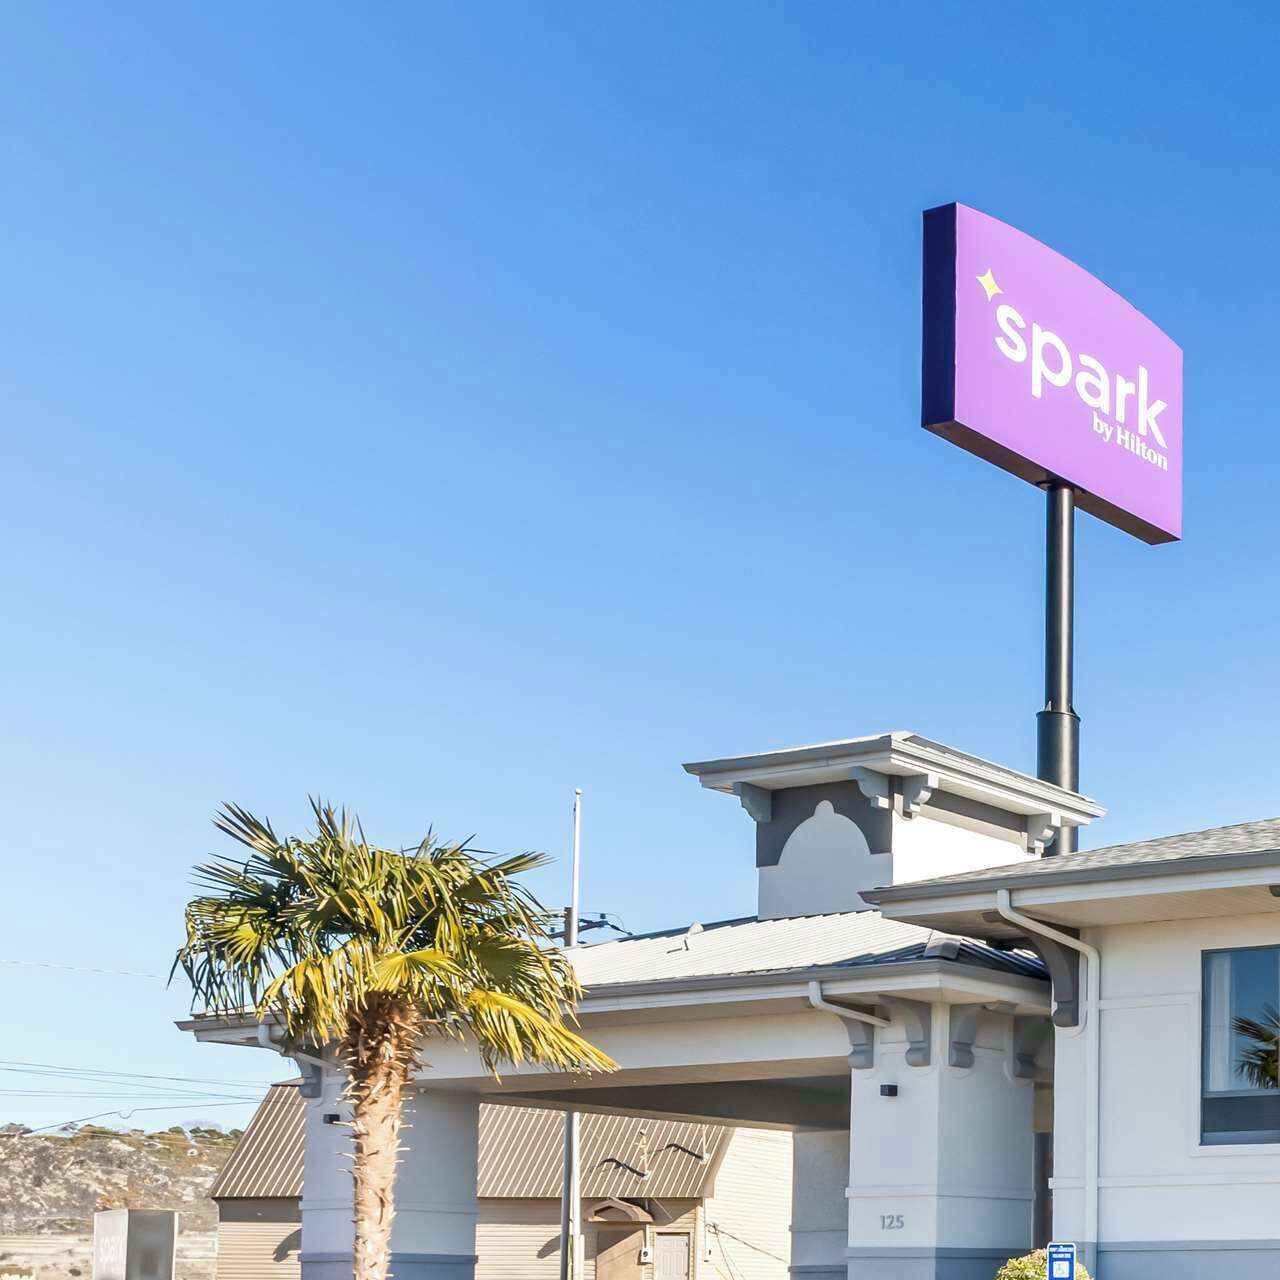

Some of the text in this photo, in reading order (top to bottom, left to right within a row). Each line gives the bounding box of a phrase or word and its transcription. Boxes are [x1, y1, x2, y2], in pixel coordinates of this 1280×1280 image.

[994, 304, 1169, 450] spark
[1093, 411, 1168, 471] by Hilton
[880, 1214, 905, 1230] 125
